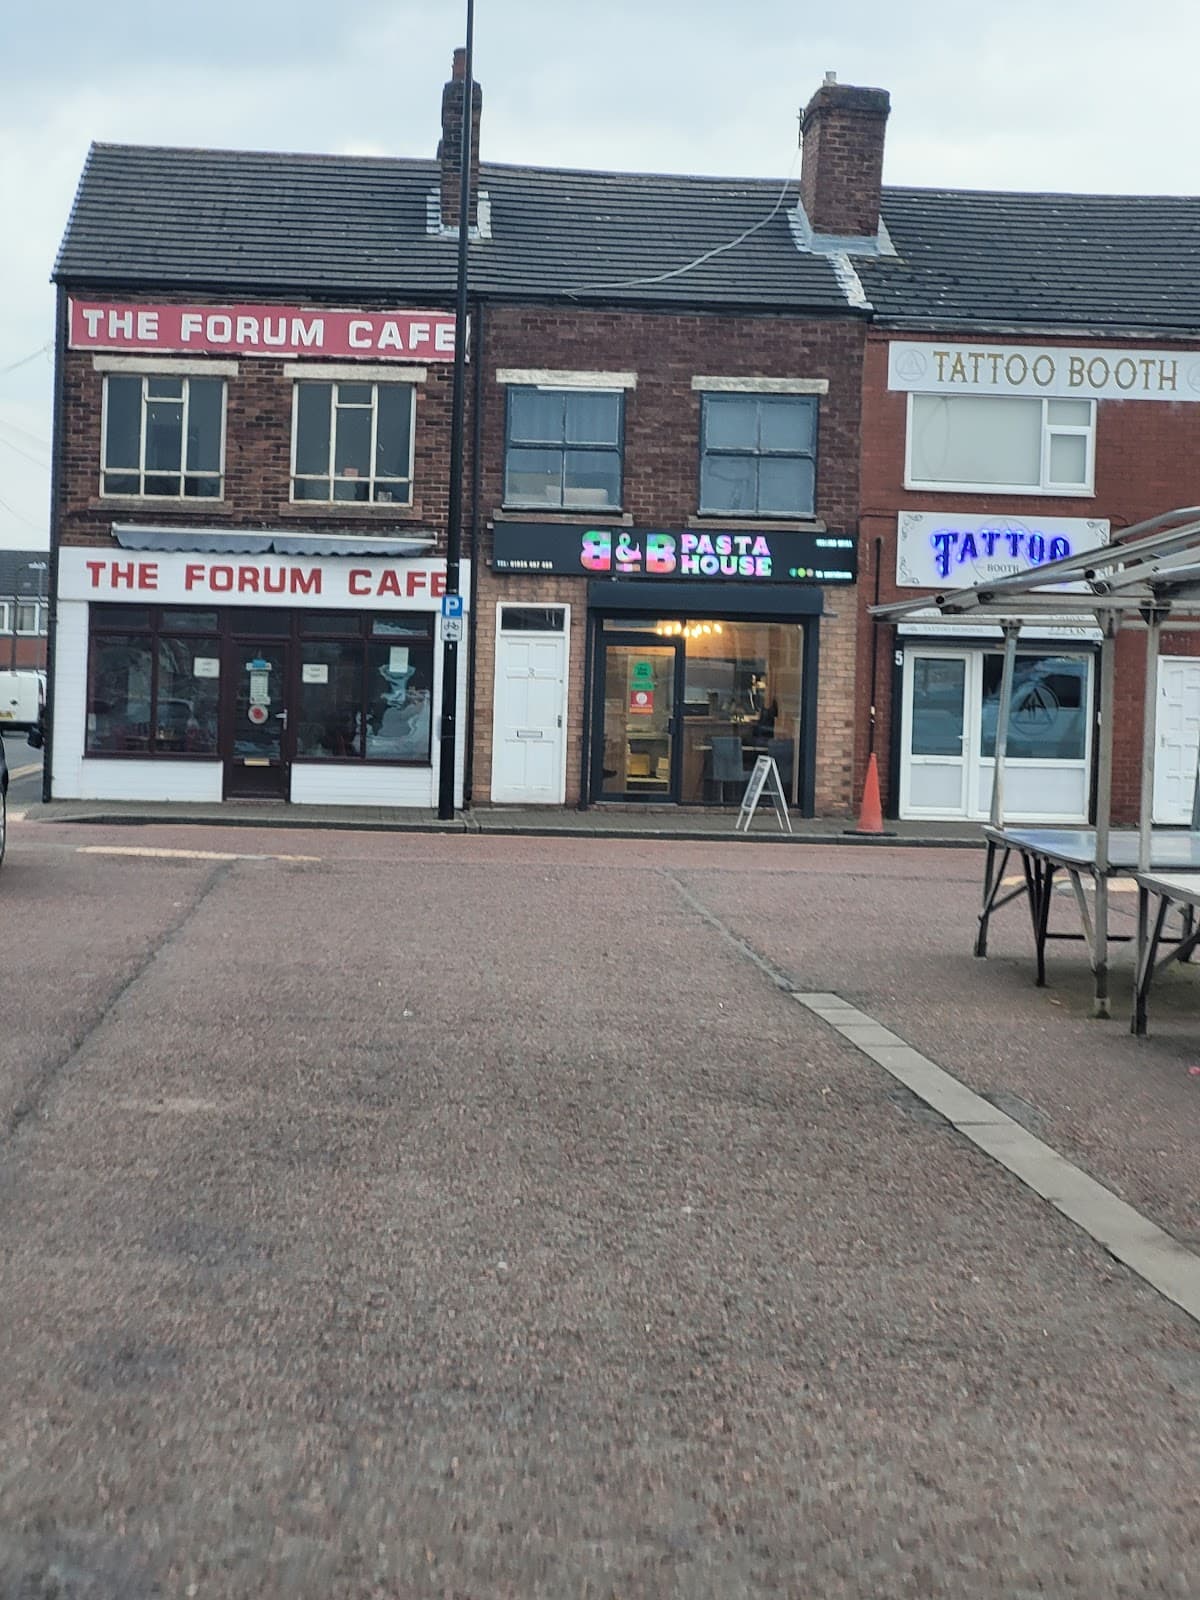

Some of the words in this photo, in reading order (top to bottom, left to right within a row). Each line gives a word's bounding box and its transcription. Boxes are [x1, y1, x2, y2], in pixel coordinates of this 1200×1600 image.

[82, 309, 159, 341] THE
[180, 313, 324, 347] FORUM
[348, 320, 456, 351] CAFE
[933, 351, 1056, 387] TATTOO
[1068, 356, 1178, 391] BOOTH
[580, 530, 676, 573] B&B
[681, 533, 770, 555] PASTA
[933, 532, 1070, 577] TATTOO
[86, 561, 158, 590] THE
[185, 564, 322, 596] FORUM
[348, 569, 448, 598] CAFE
[681, 555, 772, 577] HOUSE
[987, 563, 1020, 574] BOOTH
[446, 598, 460, 616] P
[895, 650, 903, 666] 5
